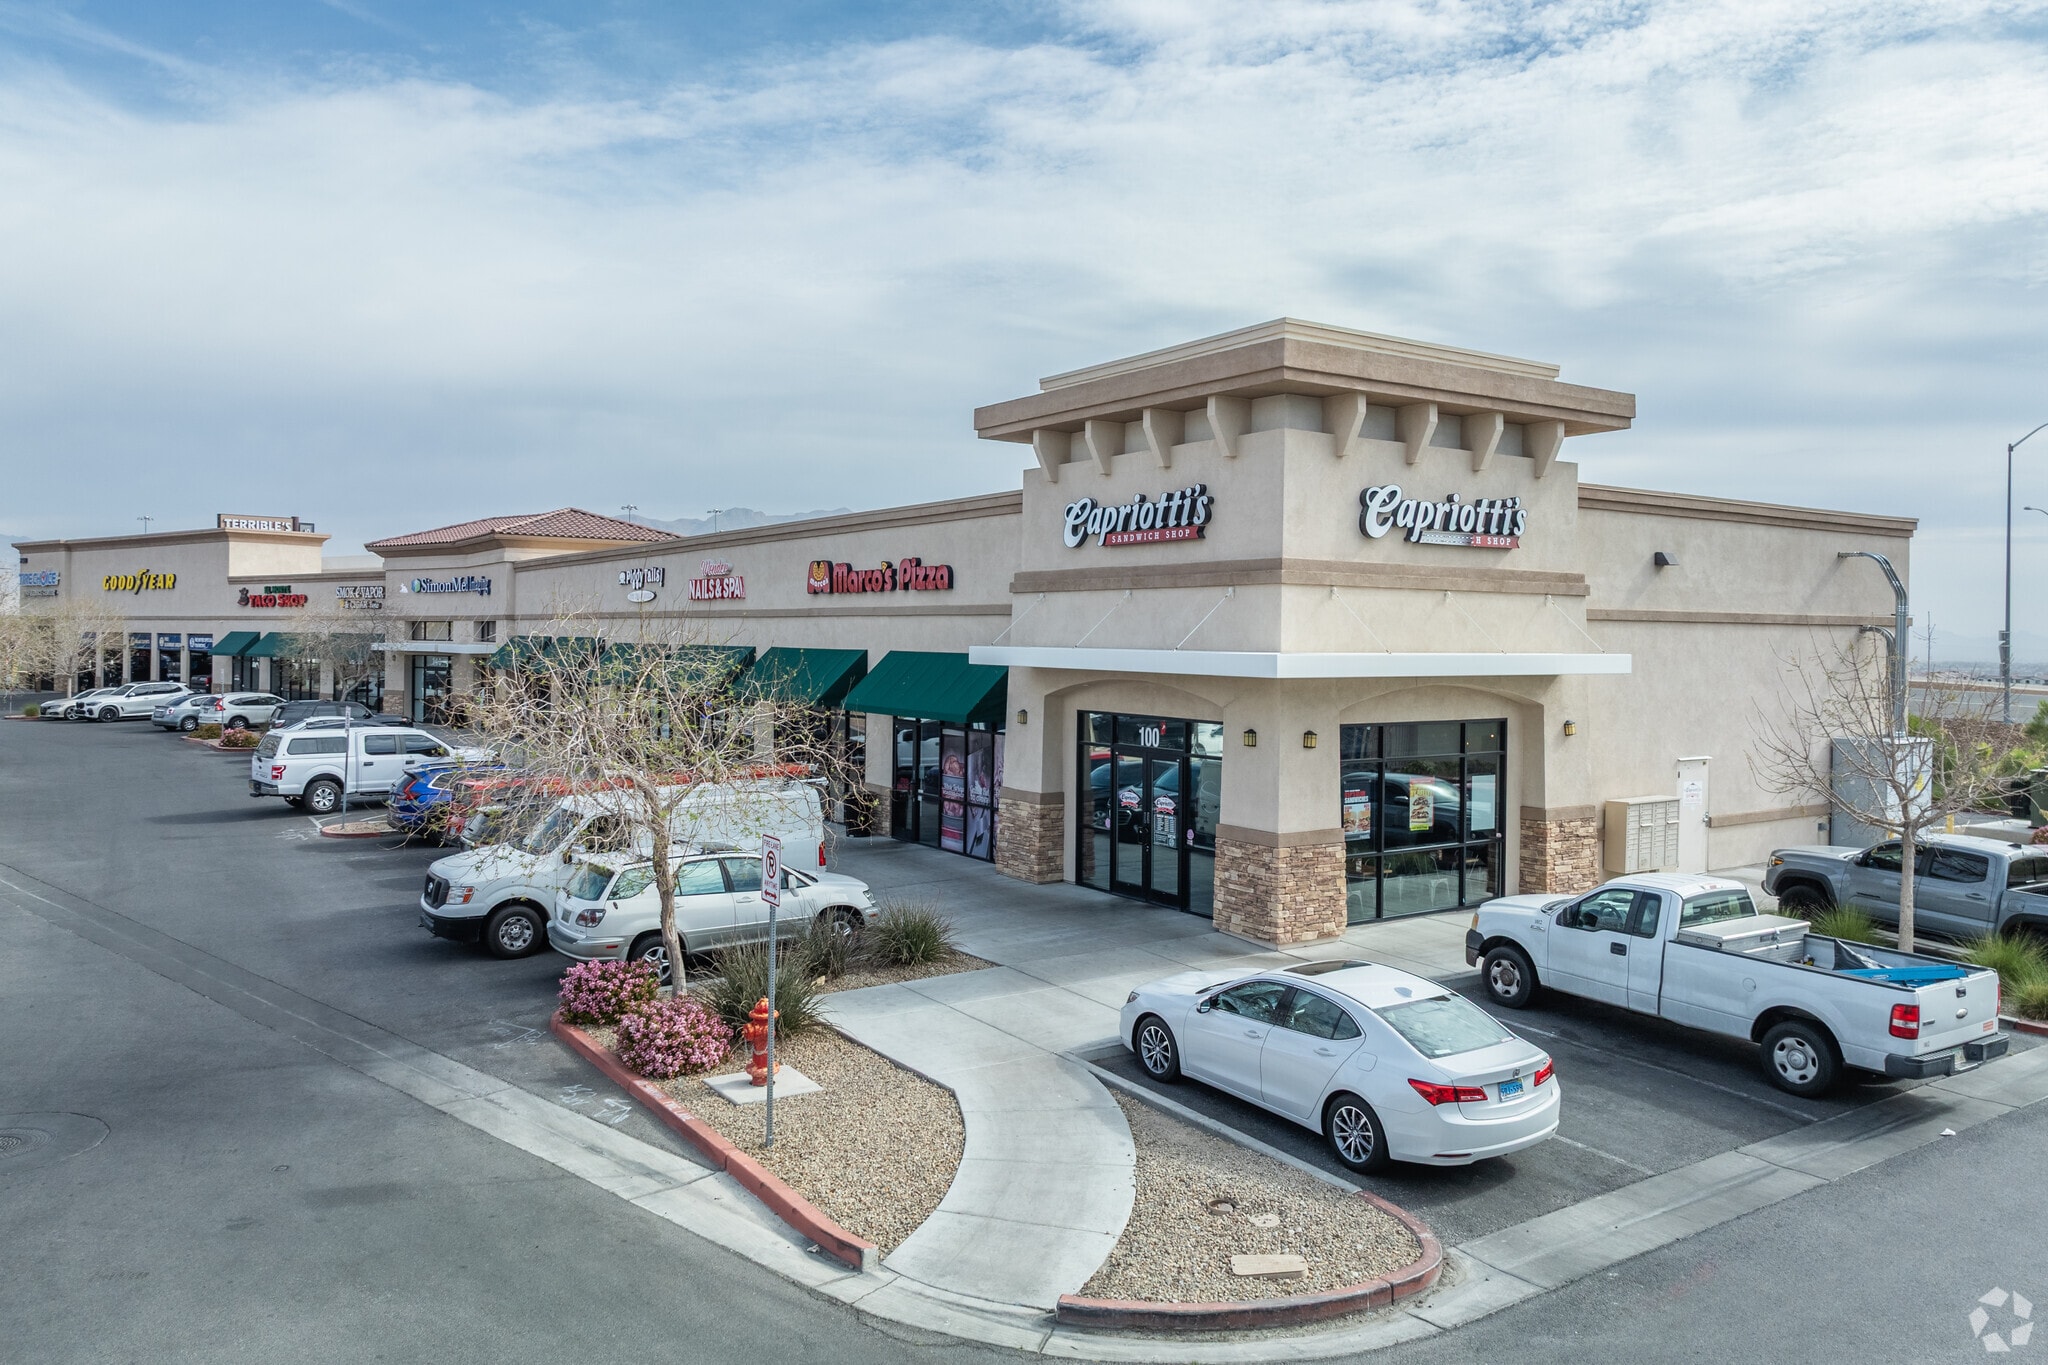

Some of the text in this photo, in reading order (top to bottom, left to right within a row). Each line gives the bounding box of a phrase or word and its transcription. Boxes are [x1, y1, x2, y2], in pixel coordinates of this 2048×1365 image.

[1064, 483, 1209, 548] Capriotti's
[1362, 484, 1528, 542] Capriotti's
[223, 518, 292, 531] TERRIBLE'S
[1111, 529, 1191, 543] SANDWICH SHOP
[1487, 536, 1511, 546] SHOP
[103, 569, 176, 594] GOODYEAR
[833, 557, 950, 593] Marco's Pizza
[688, 578, 714, 600] NAILS
[723, 576, 744, 598] SPA
[249, 594, 306, 607] TACO SHOP
[1139, 726, 1160, 747] 100
